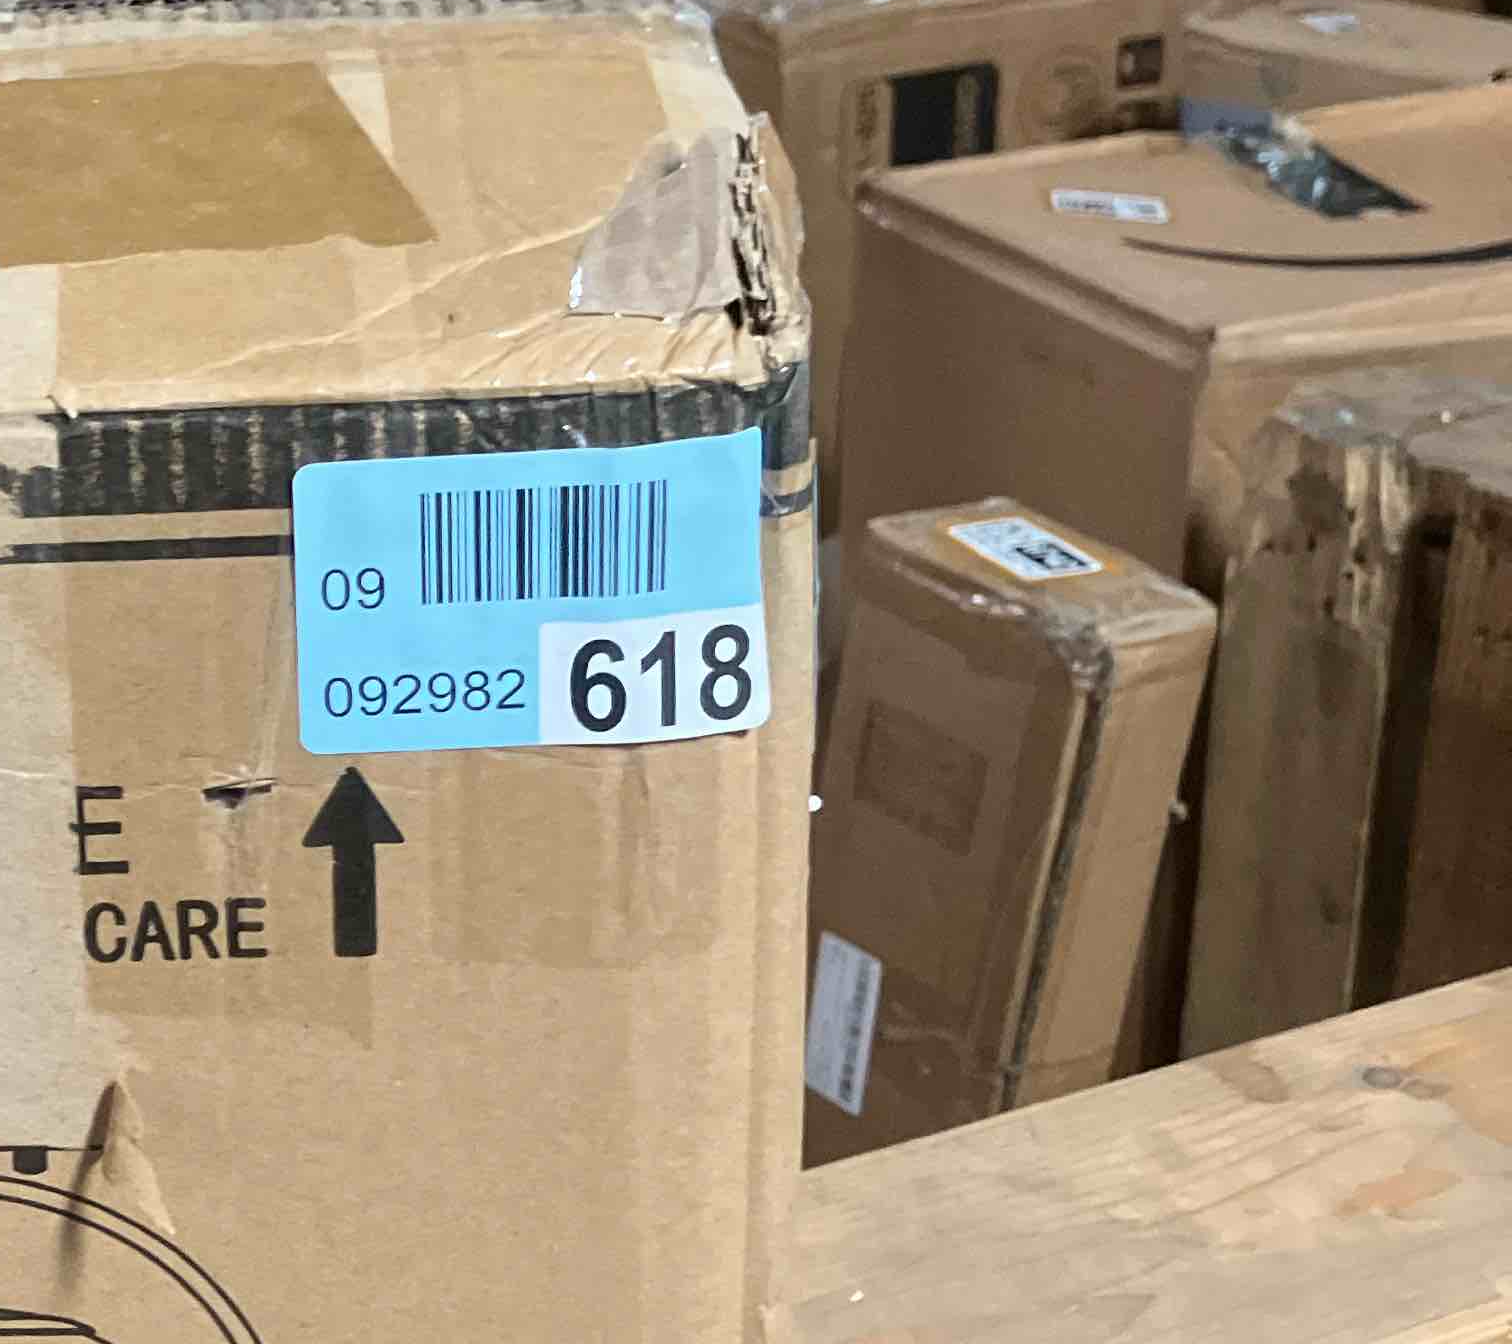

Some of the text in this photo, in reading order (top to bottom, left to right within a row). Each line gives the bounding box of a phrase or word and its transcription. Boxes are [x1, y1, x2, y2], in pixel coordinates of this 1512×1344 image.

[321, 567, 385, 611] 09
[324, 623, 753, 733] 092982 618
[84, 897, 268, 964] CARE
